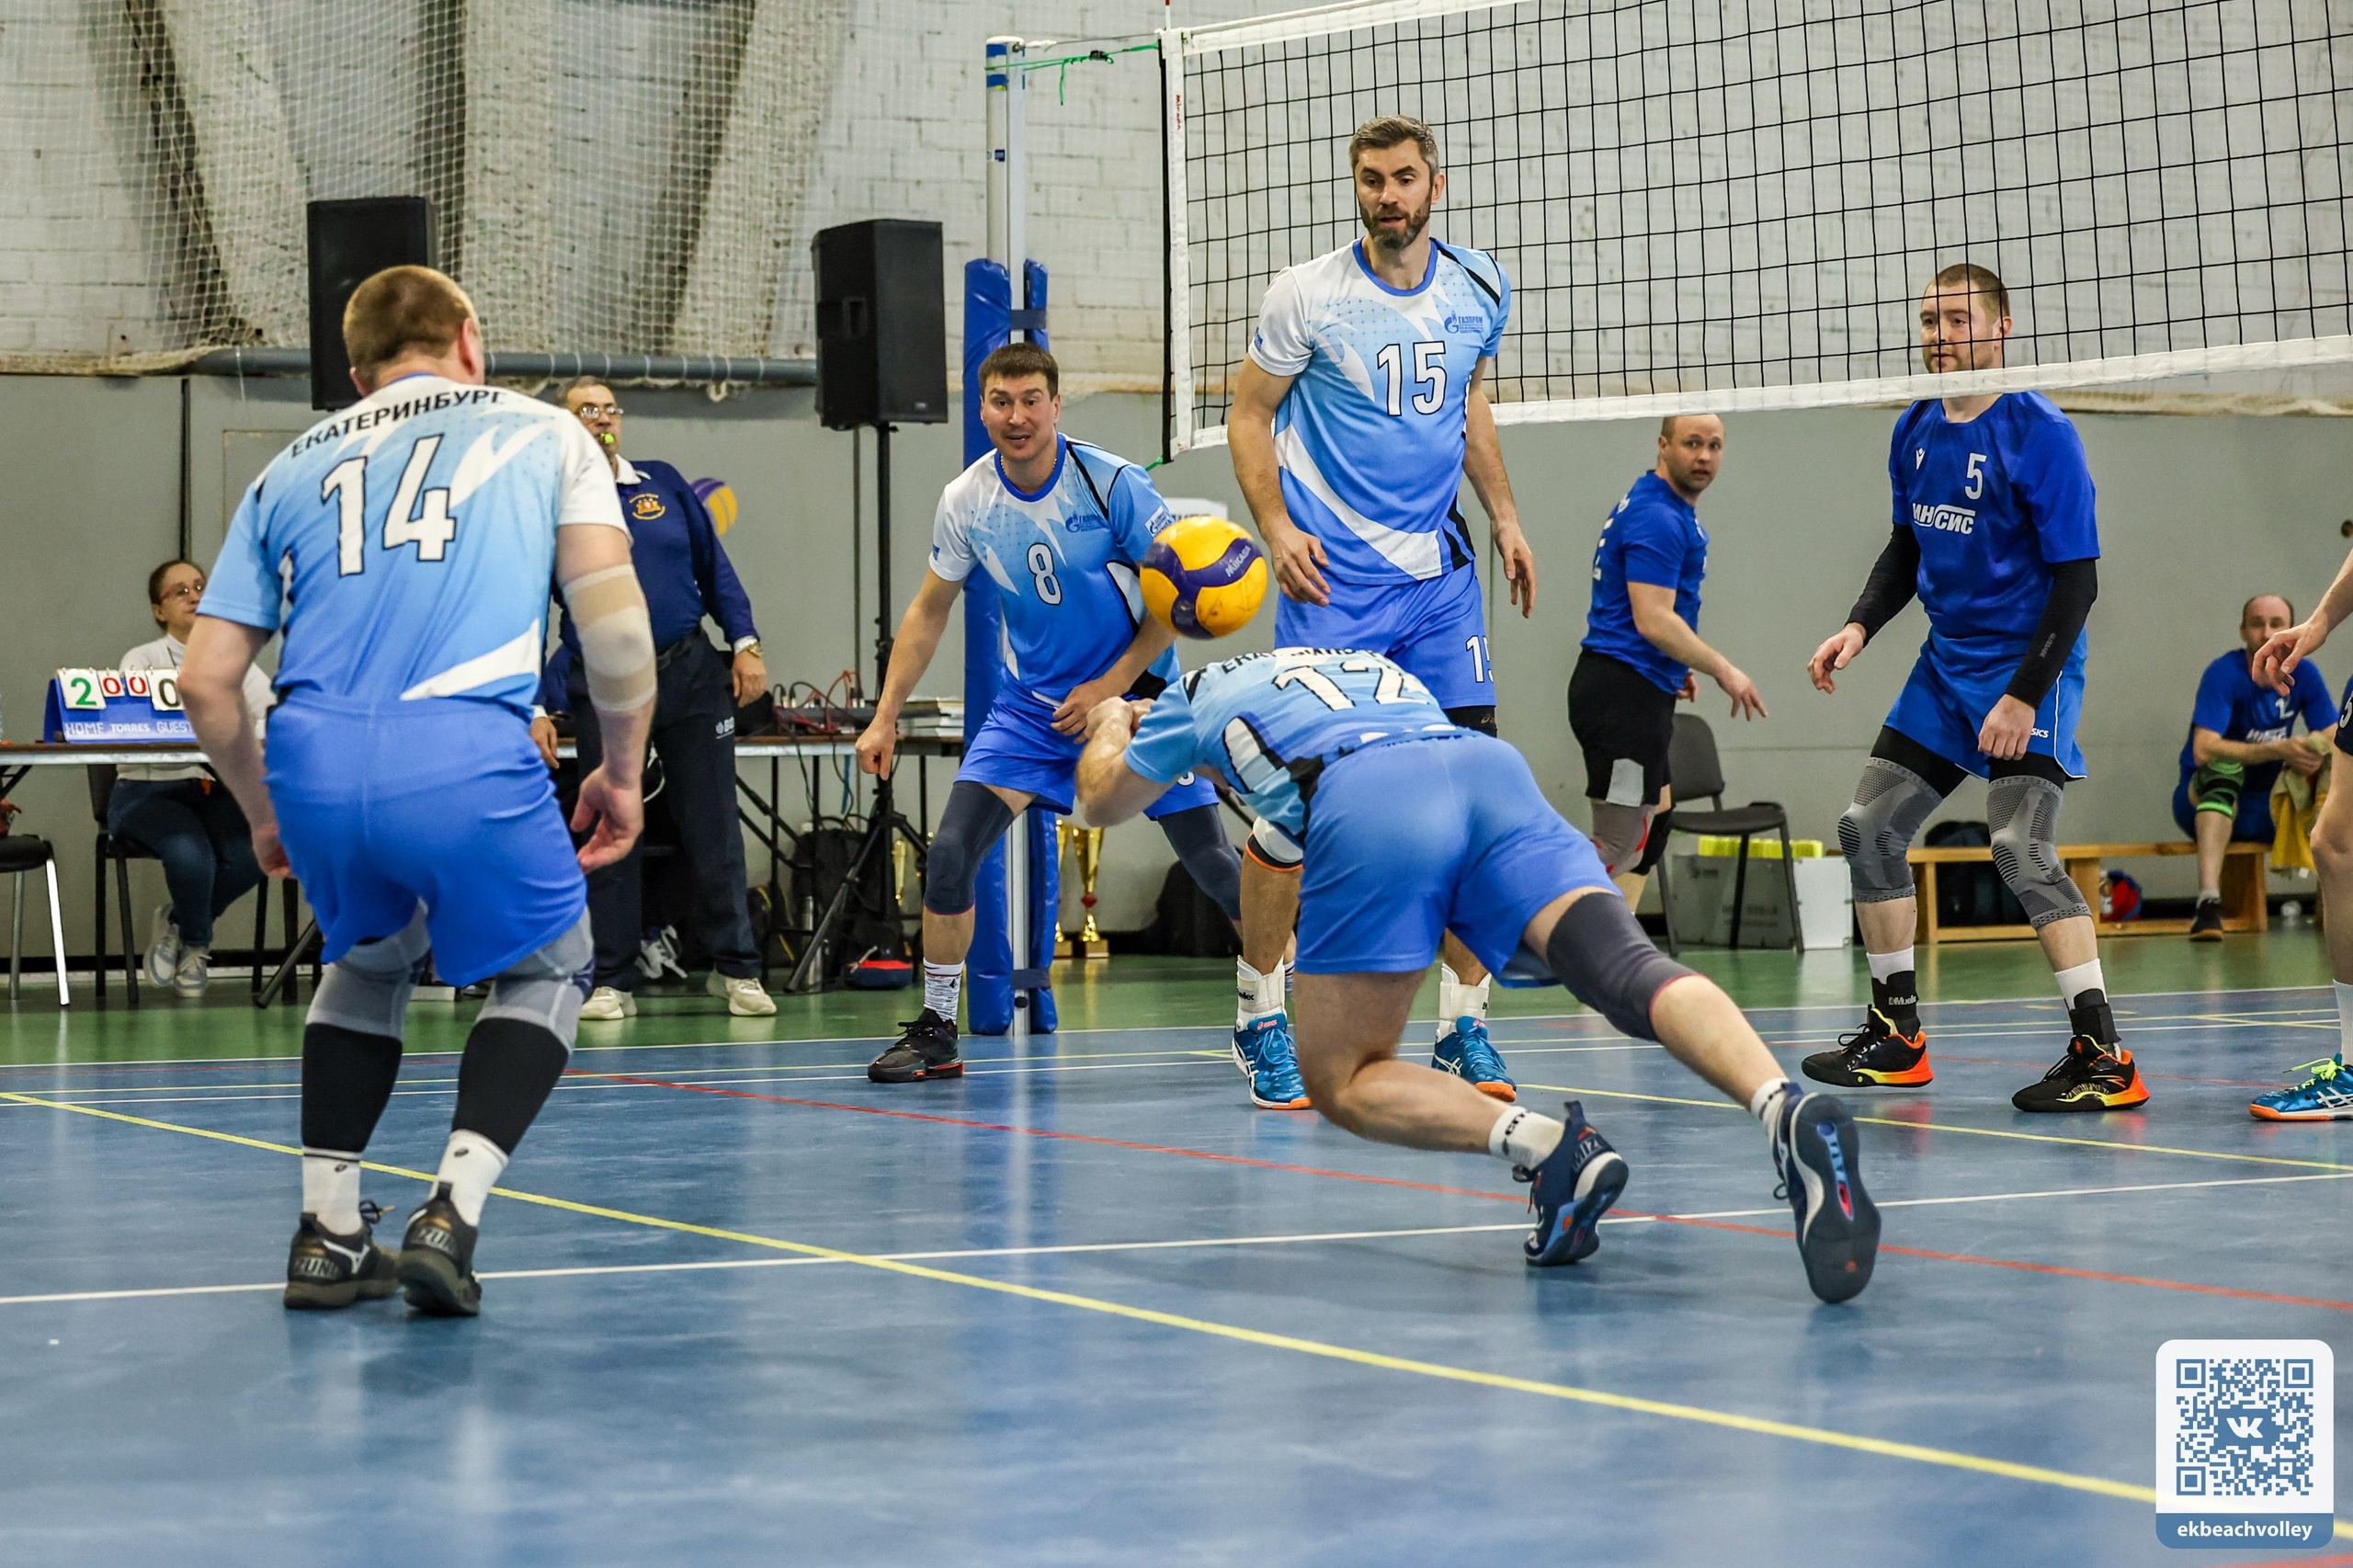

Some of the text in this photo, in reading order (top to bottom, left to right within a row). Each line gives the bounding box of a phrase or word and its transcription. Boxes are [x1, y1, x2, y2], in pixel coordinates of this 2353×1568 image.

[1376, 340, 1447, 416] 15
[291, 390, 506, 458] ЕКАТЕРИНБУРГ
[1964, 452, 1987, 500] 5
[321, 433, 457, 577] 14
[1027, 542, 1063, 606] 8
[71, 676, 181, 708] 2 0 0 0
[1271, 661, 1431, 711] 12
[65, 722, 193, 734] HOME TORRES GUEST
[2030, 727, 2049, 739] SICS
